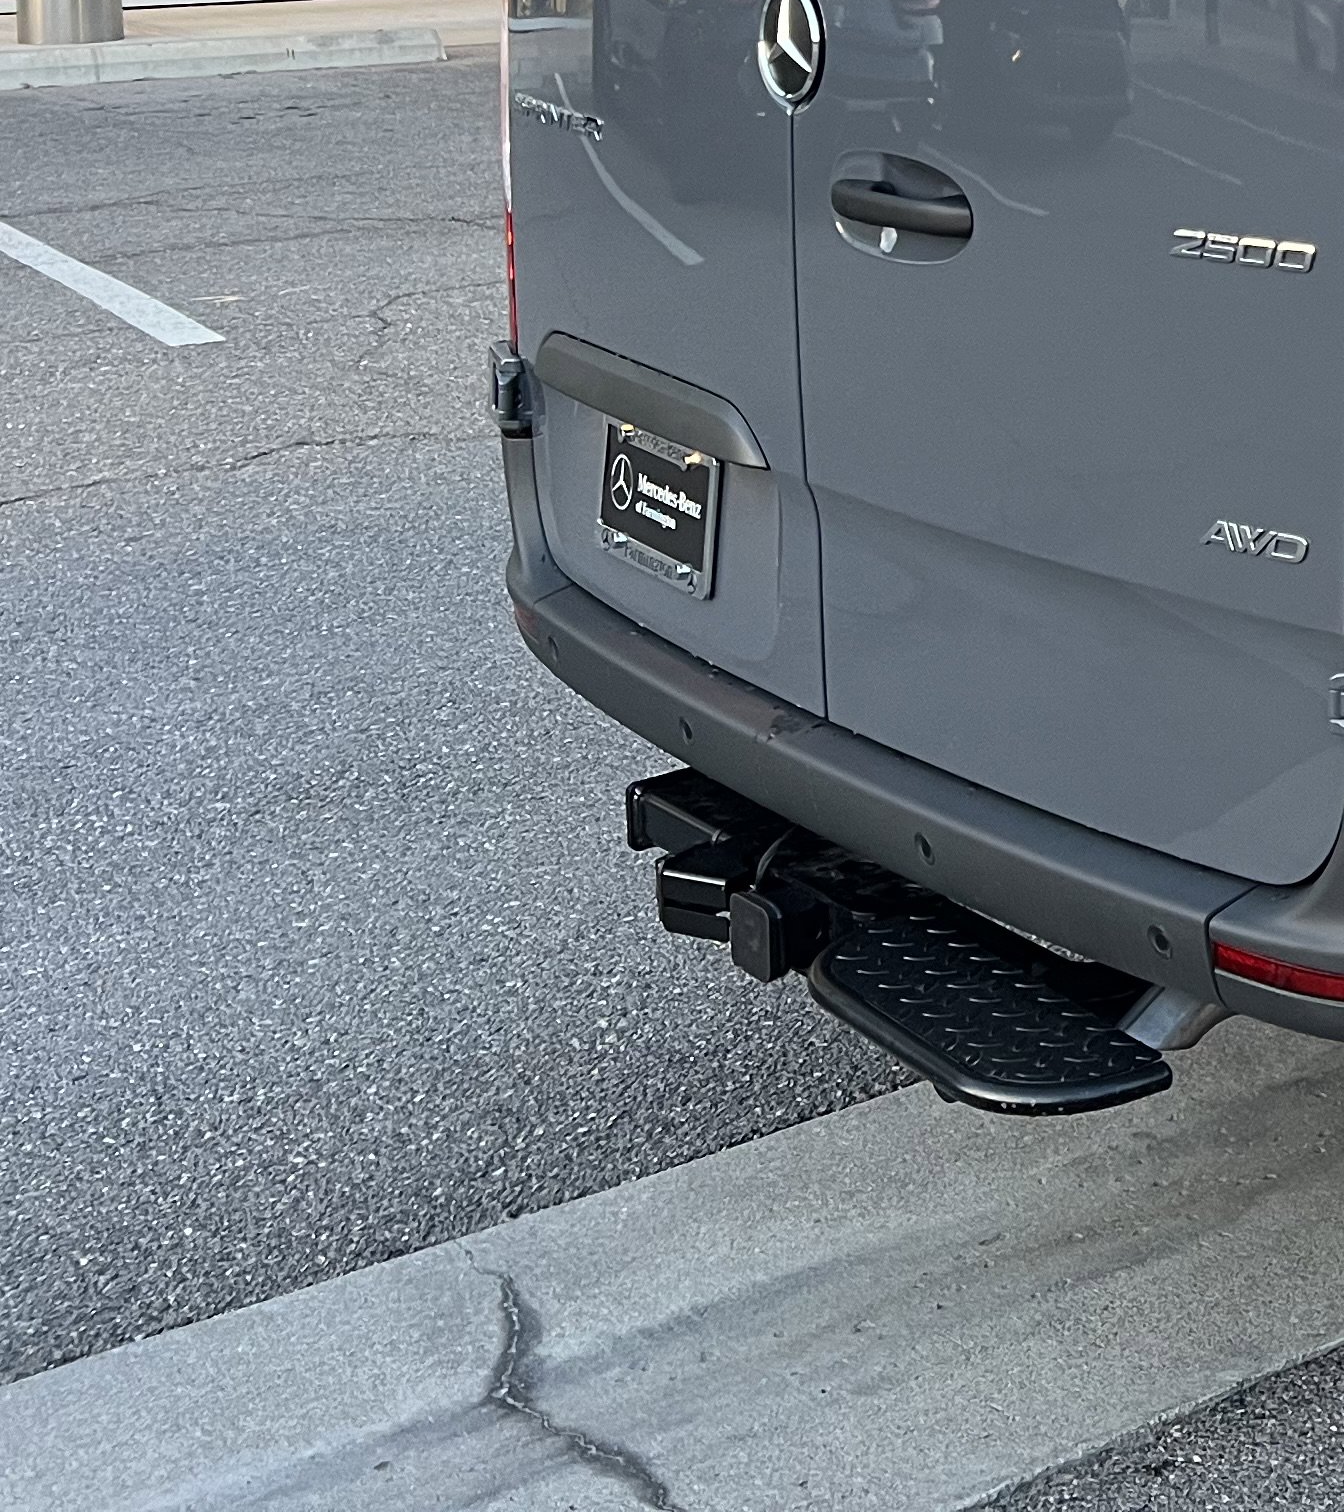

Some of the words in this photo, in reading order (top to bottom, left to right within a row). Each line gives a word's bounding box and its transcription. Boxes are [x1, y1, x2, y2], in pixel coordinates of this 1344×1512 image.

[1170, 228, 1316, 273] 2500
[637, 472, 702, 520] Mercedes-Benz
[1201, 520, 1310, 564] AWD
